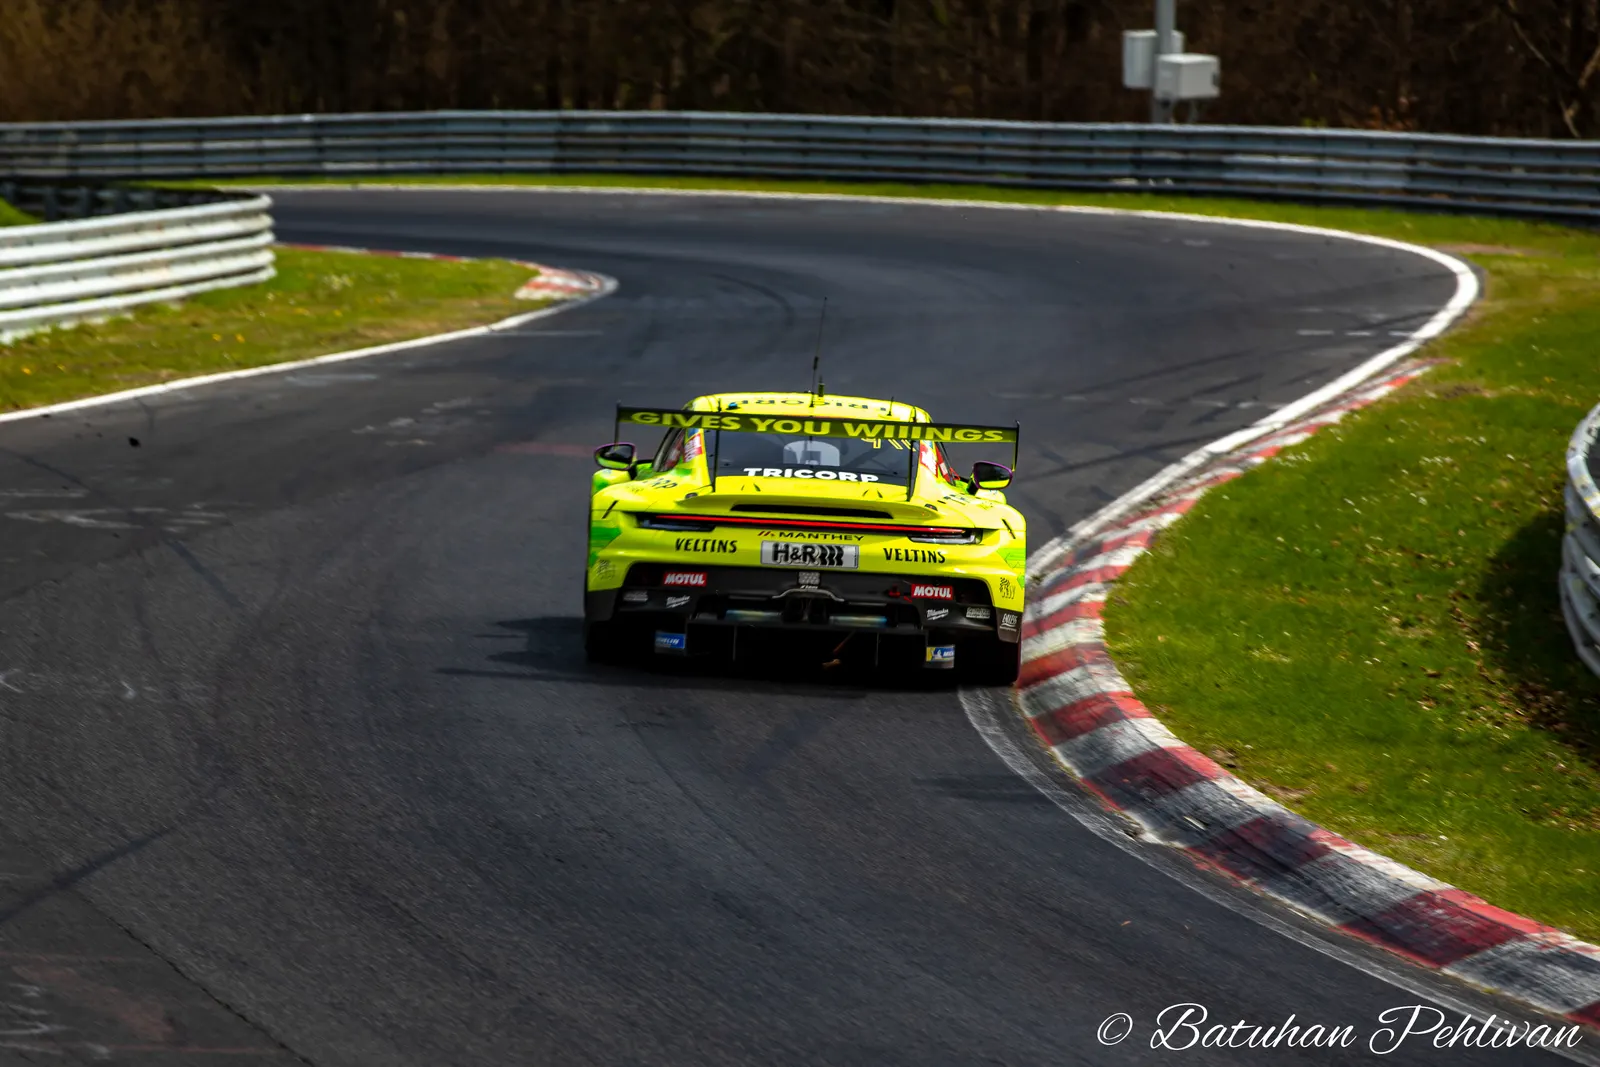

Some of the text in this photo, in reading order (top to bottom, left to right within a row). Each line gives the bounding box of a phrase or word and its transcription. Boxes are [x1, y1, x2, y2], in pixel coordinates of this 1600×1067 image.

[631, 411, 1003, 441] GIVES YOU WIIINGS
[743, 467, 878, 483] TRICORP
[780, 532, 864, 543] MANTHEY
[675, 538, 737, 553] VELTINS
[772, 543, 817, 564] H&R
[883, 547, 946, 563] VELTINS
[664, 573, 705, 585] MOTUL
[914, 585, 952, 598] MOTUL
